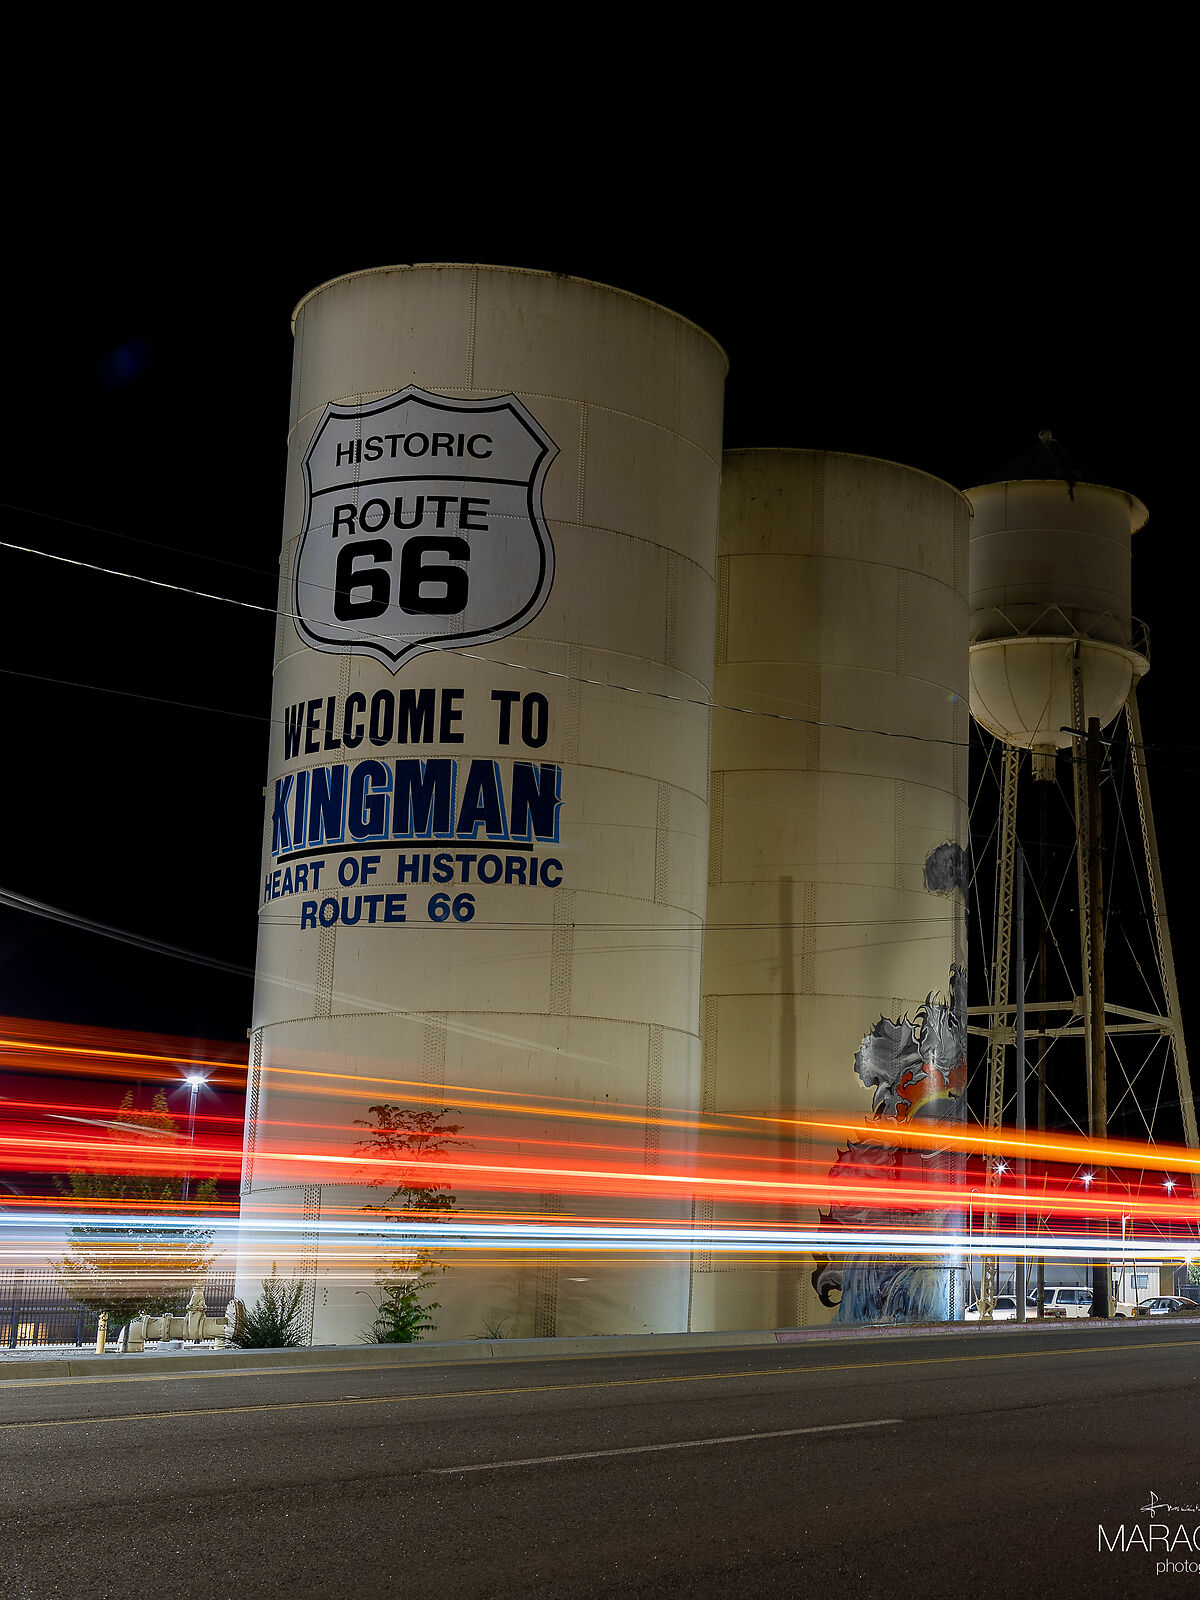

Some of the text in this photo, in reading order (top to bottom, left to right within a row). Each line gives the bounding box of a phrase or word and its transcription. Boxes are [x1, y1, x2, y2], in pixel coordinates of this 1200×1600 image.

[335, 432, 493, 468] HISTORIC
[331, 495, 491, 538] ROUTE
[334, 535, 471, 622] 66
[284, 688, 549, 761] WELCOME TO
[271, 758, 566, 857] KINGMAN
[263, 853, 564, 902] HEART OF HISTORIC
[300, 892, 476, 930] ROUTE 66
